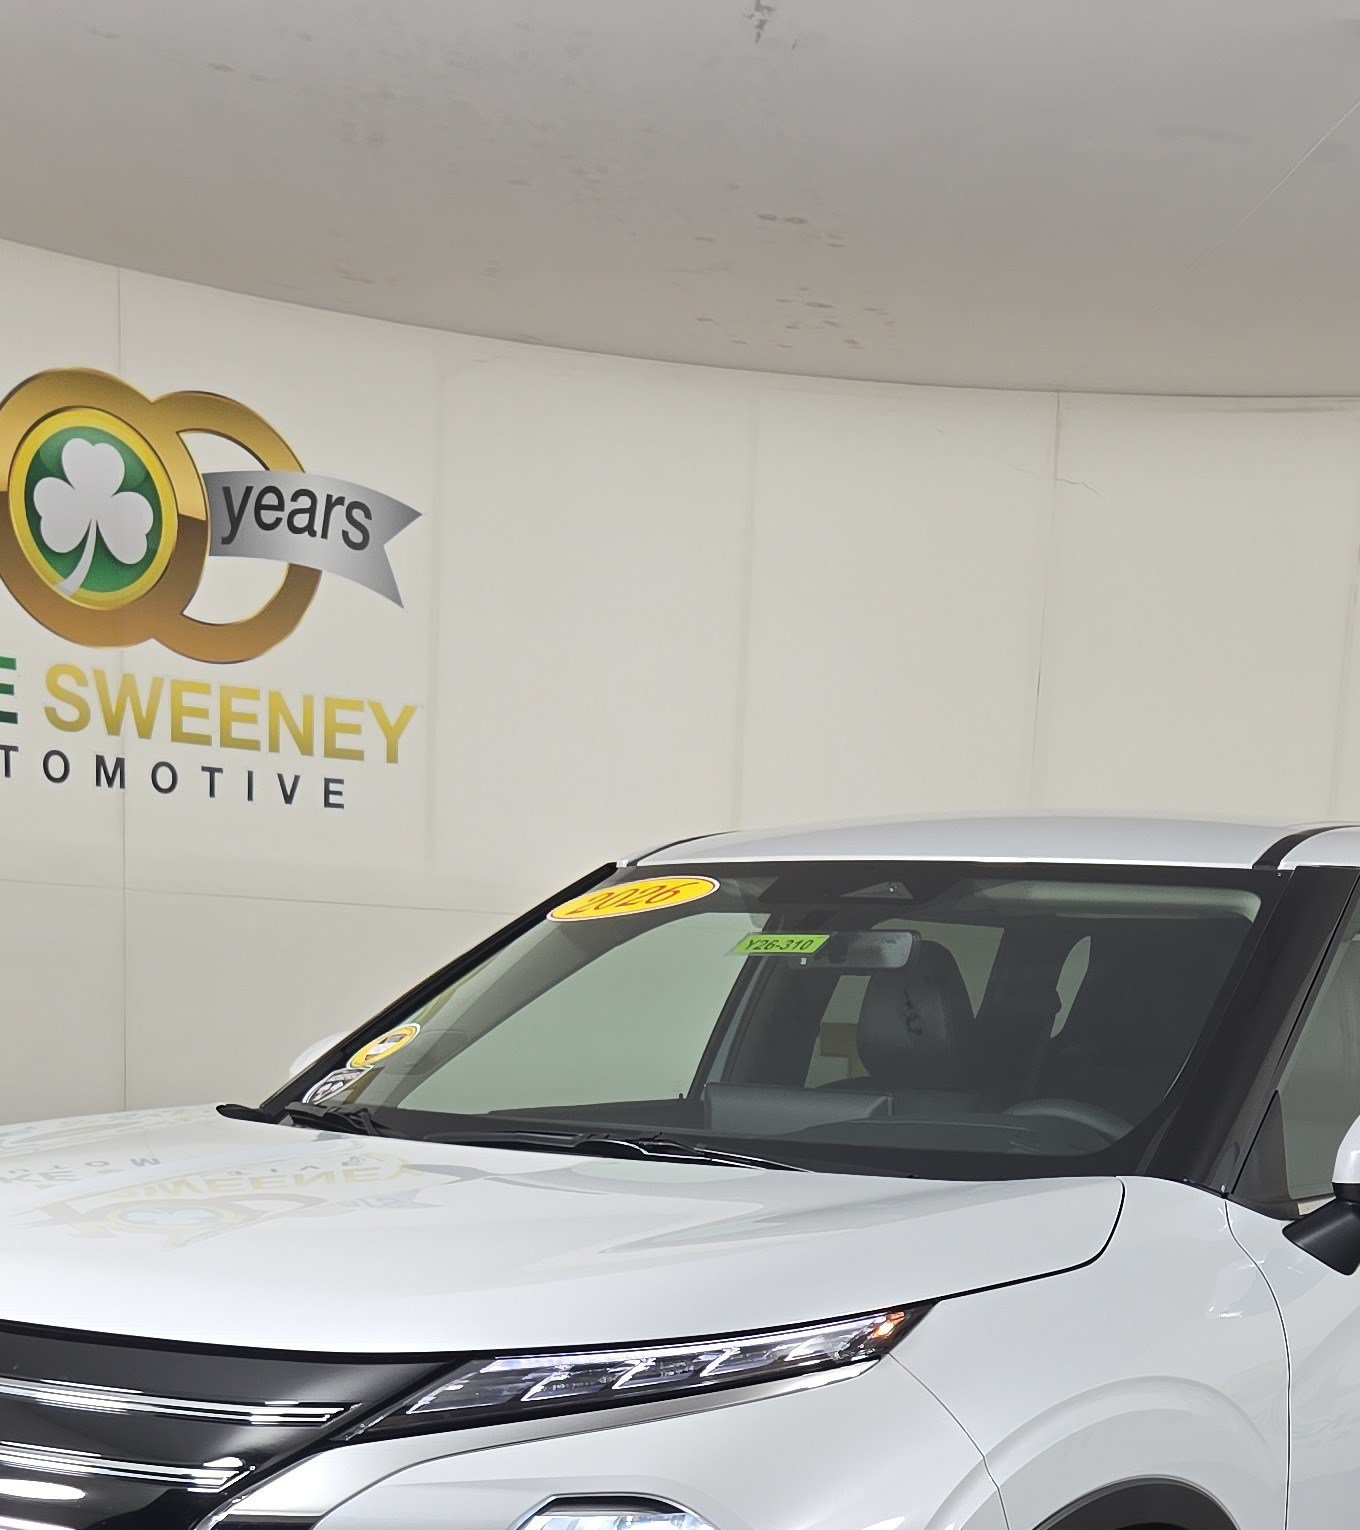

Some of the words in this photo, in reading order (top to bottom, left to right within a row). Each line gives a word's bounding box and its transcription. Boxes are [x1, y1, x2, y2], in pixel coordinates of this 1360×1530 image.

[219, 482, 373, 551] years
[43, 663, 418, 765] SWEENEY
[567, 881, 700, 916] 2026
[745, 938, 815, 952] Y26-310
